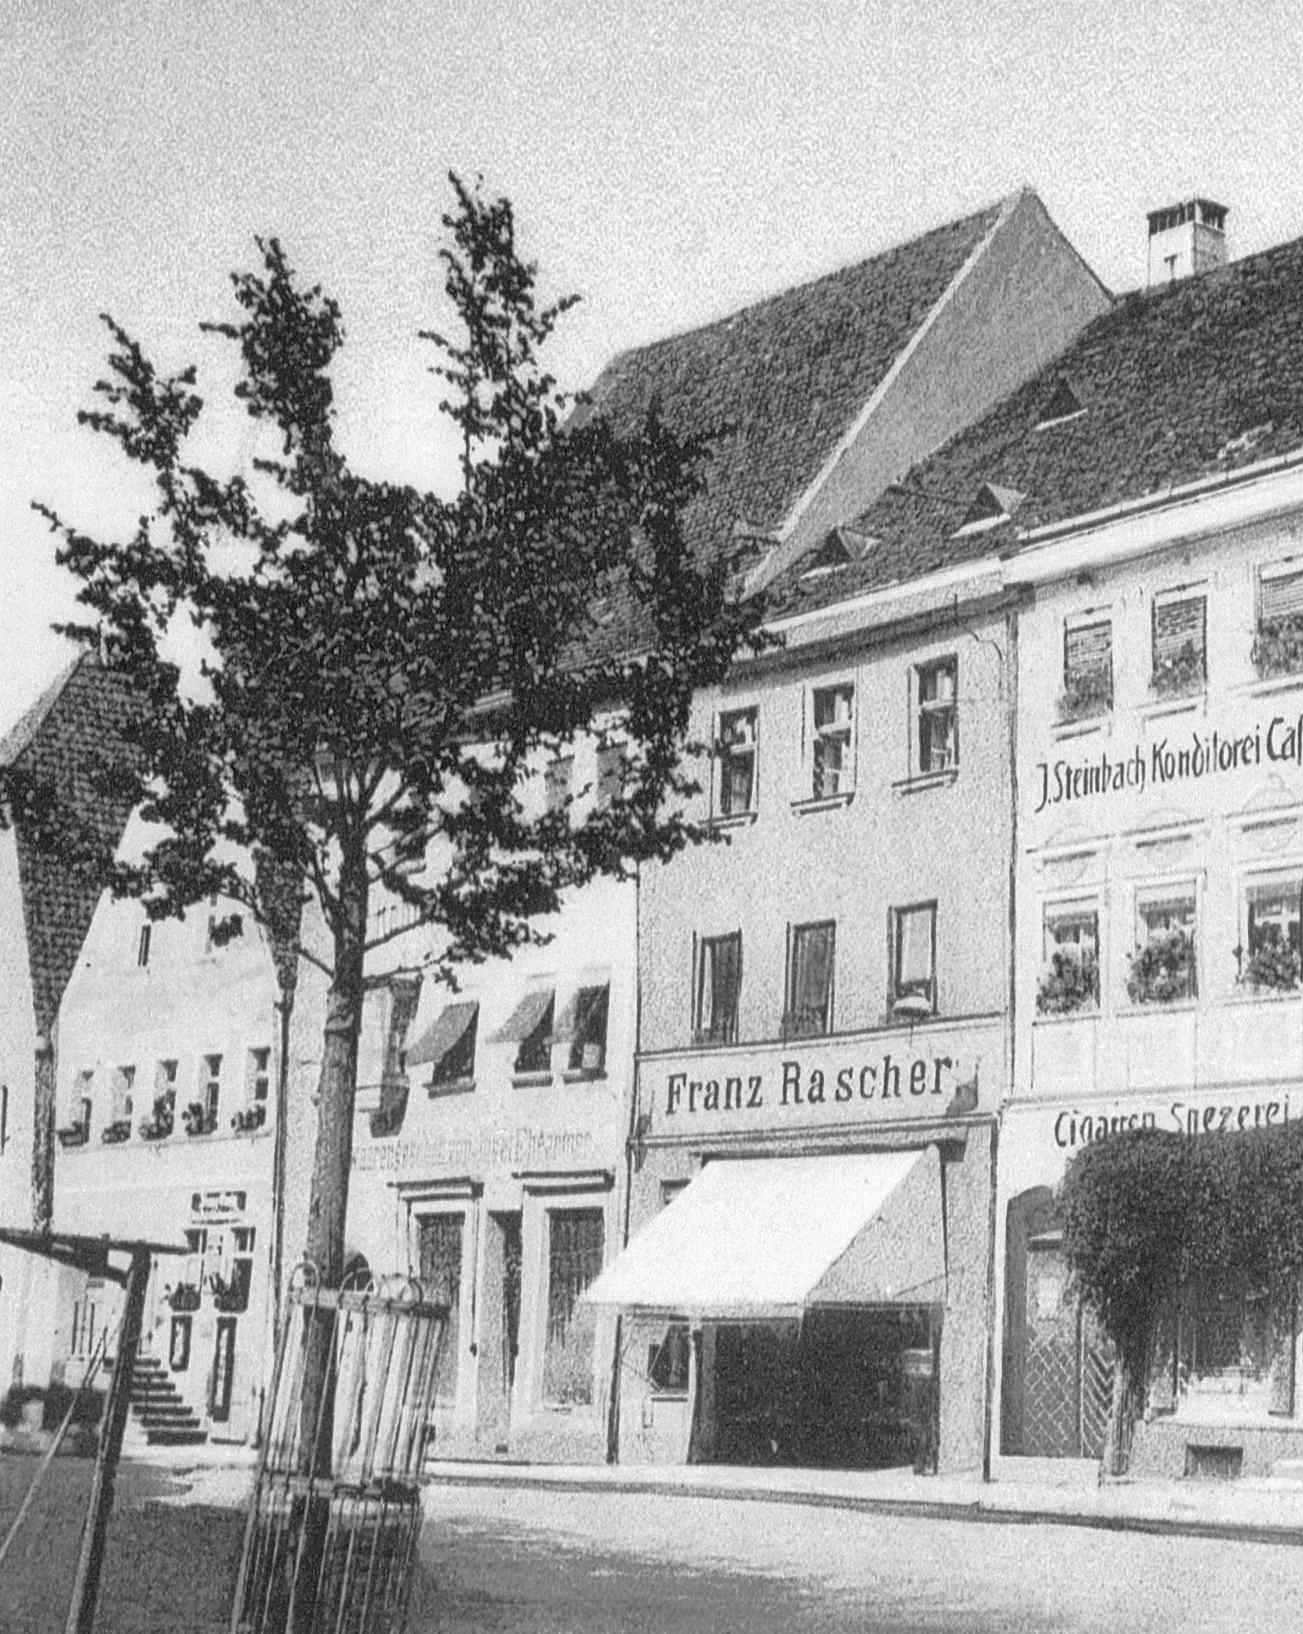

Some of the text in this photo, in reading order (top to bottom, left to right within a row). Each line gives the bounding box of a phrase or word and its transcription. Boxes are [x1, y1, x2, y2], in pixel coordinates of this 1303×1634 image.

[1152, 725, 1261, 783] Konditorei
[665, 1055, 953, 1115] Franz Rascher
